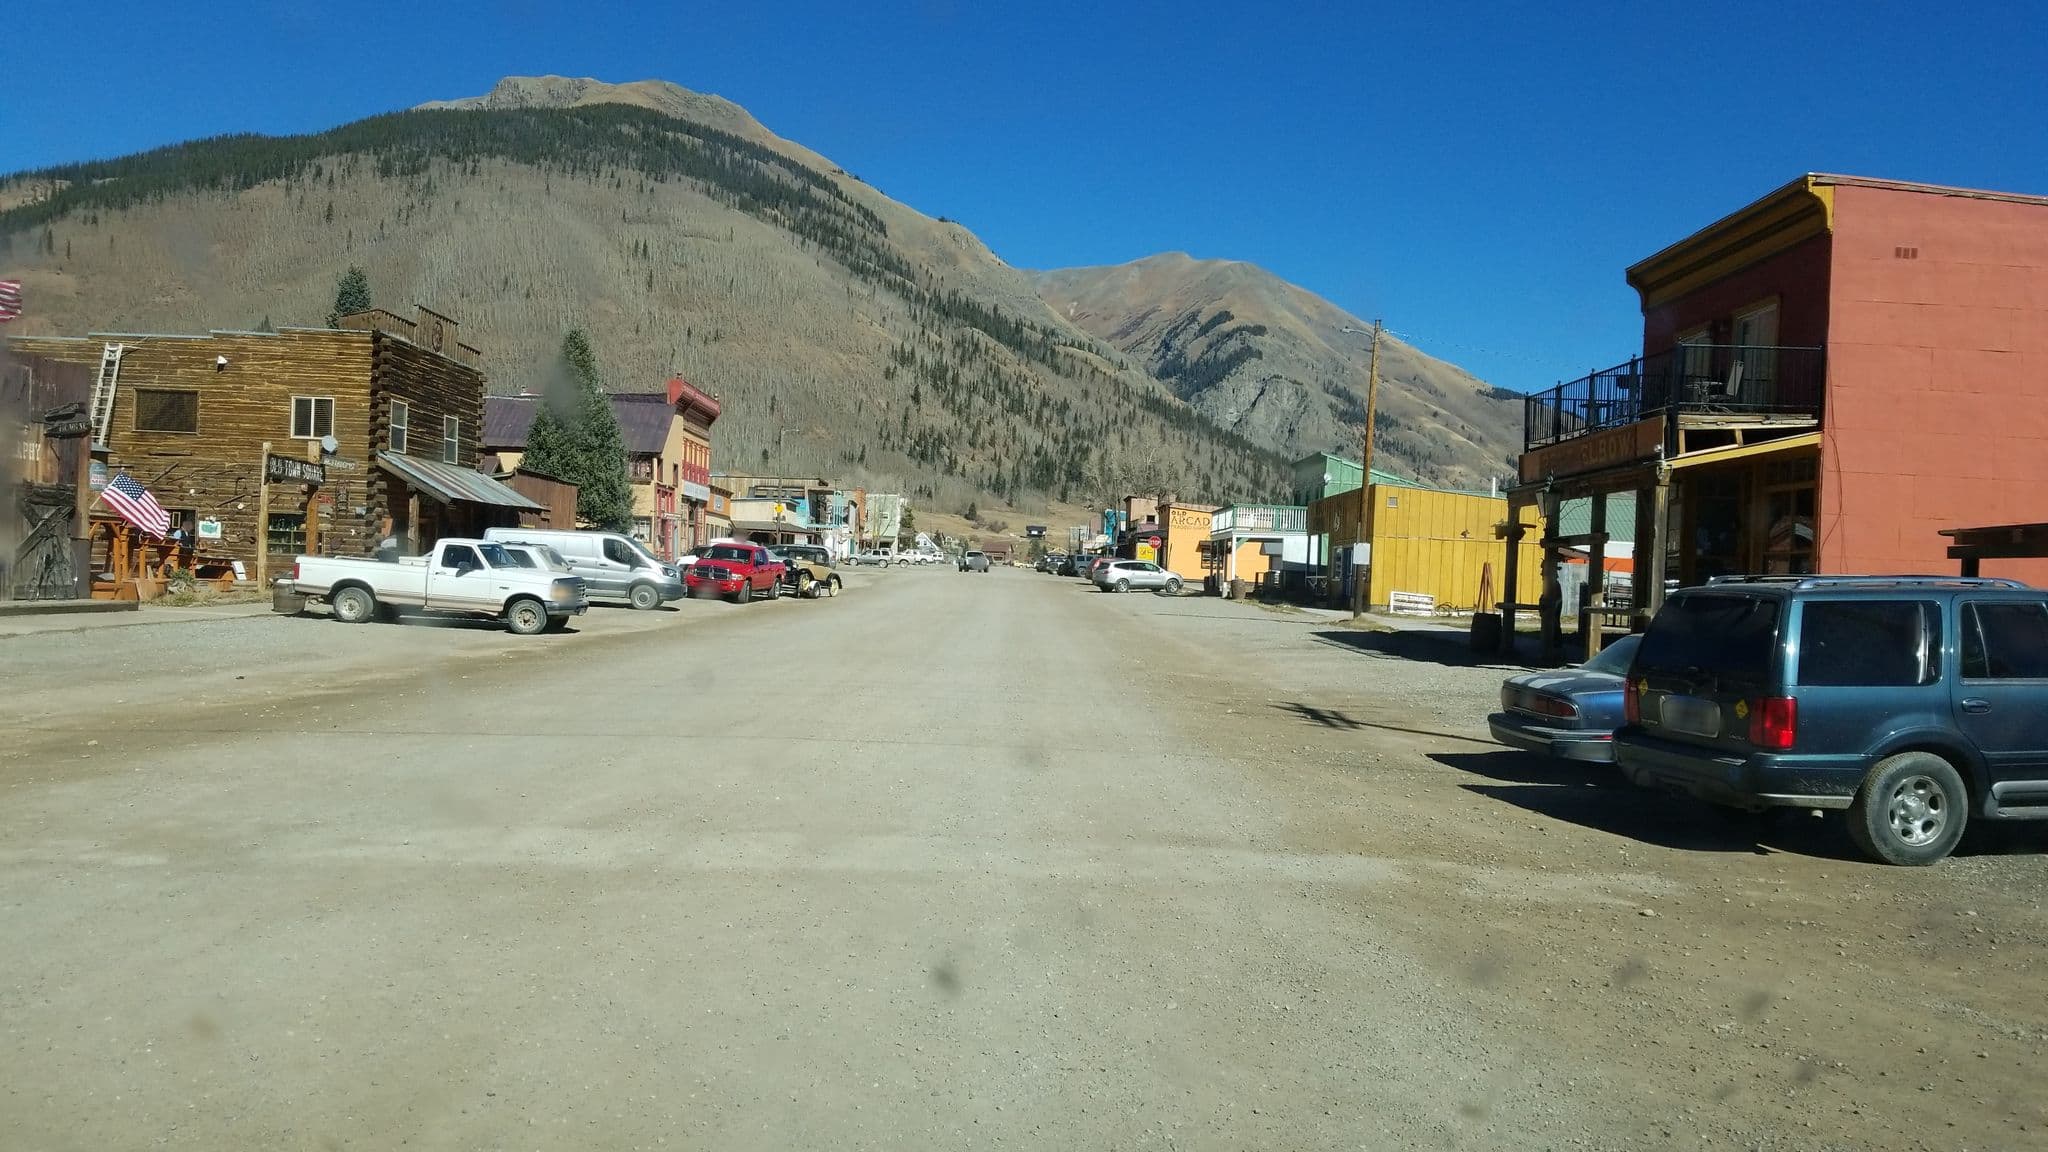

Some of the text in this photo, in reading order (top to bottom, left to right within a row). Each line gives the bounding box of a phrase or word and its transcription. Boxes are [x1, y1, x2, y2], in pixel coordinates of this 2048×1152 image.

[270, 457, 323, 482] OLD TOWN SQUARE
[1171, 516, 1211, 526] ARCAD
